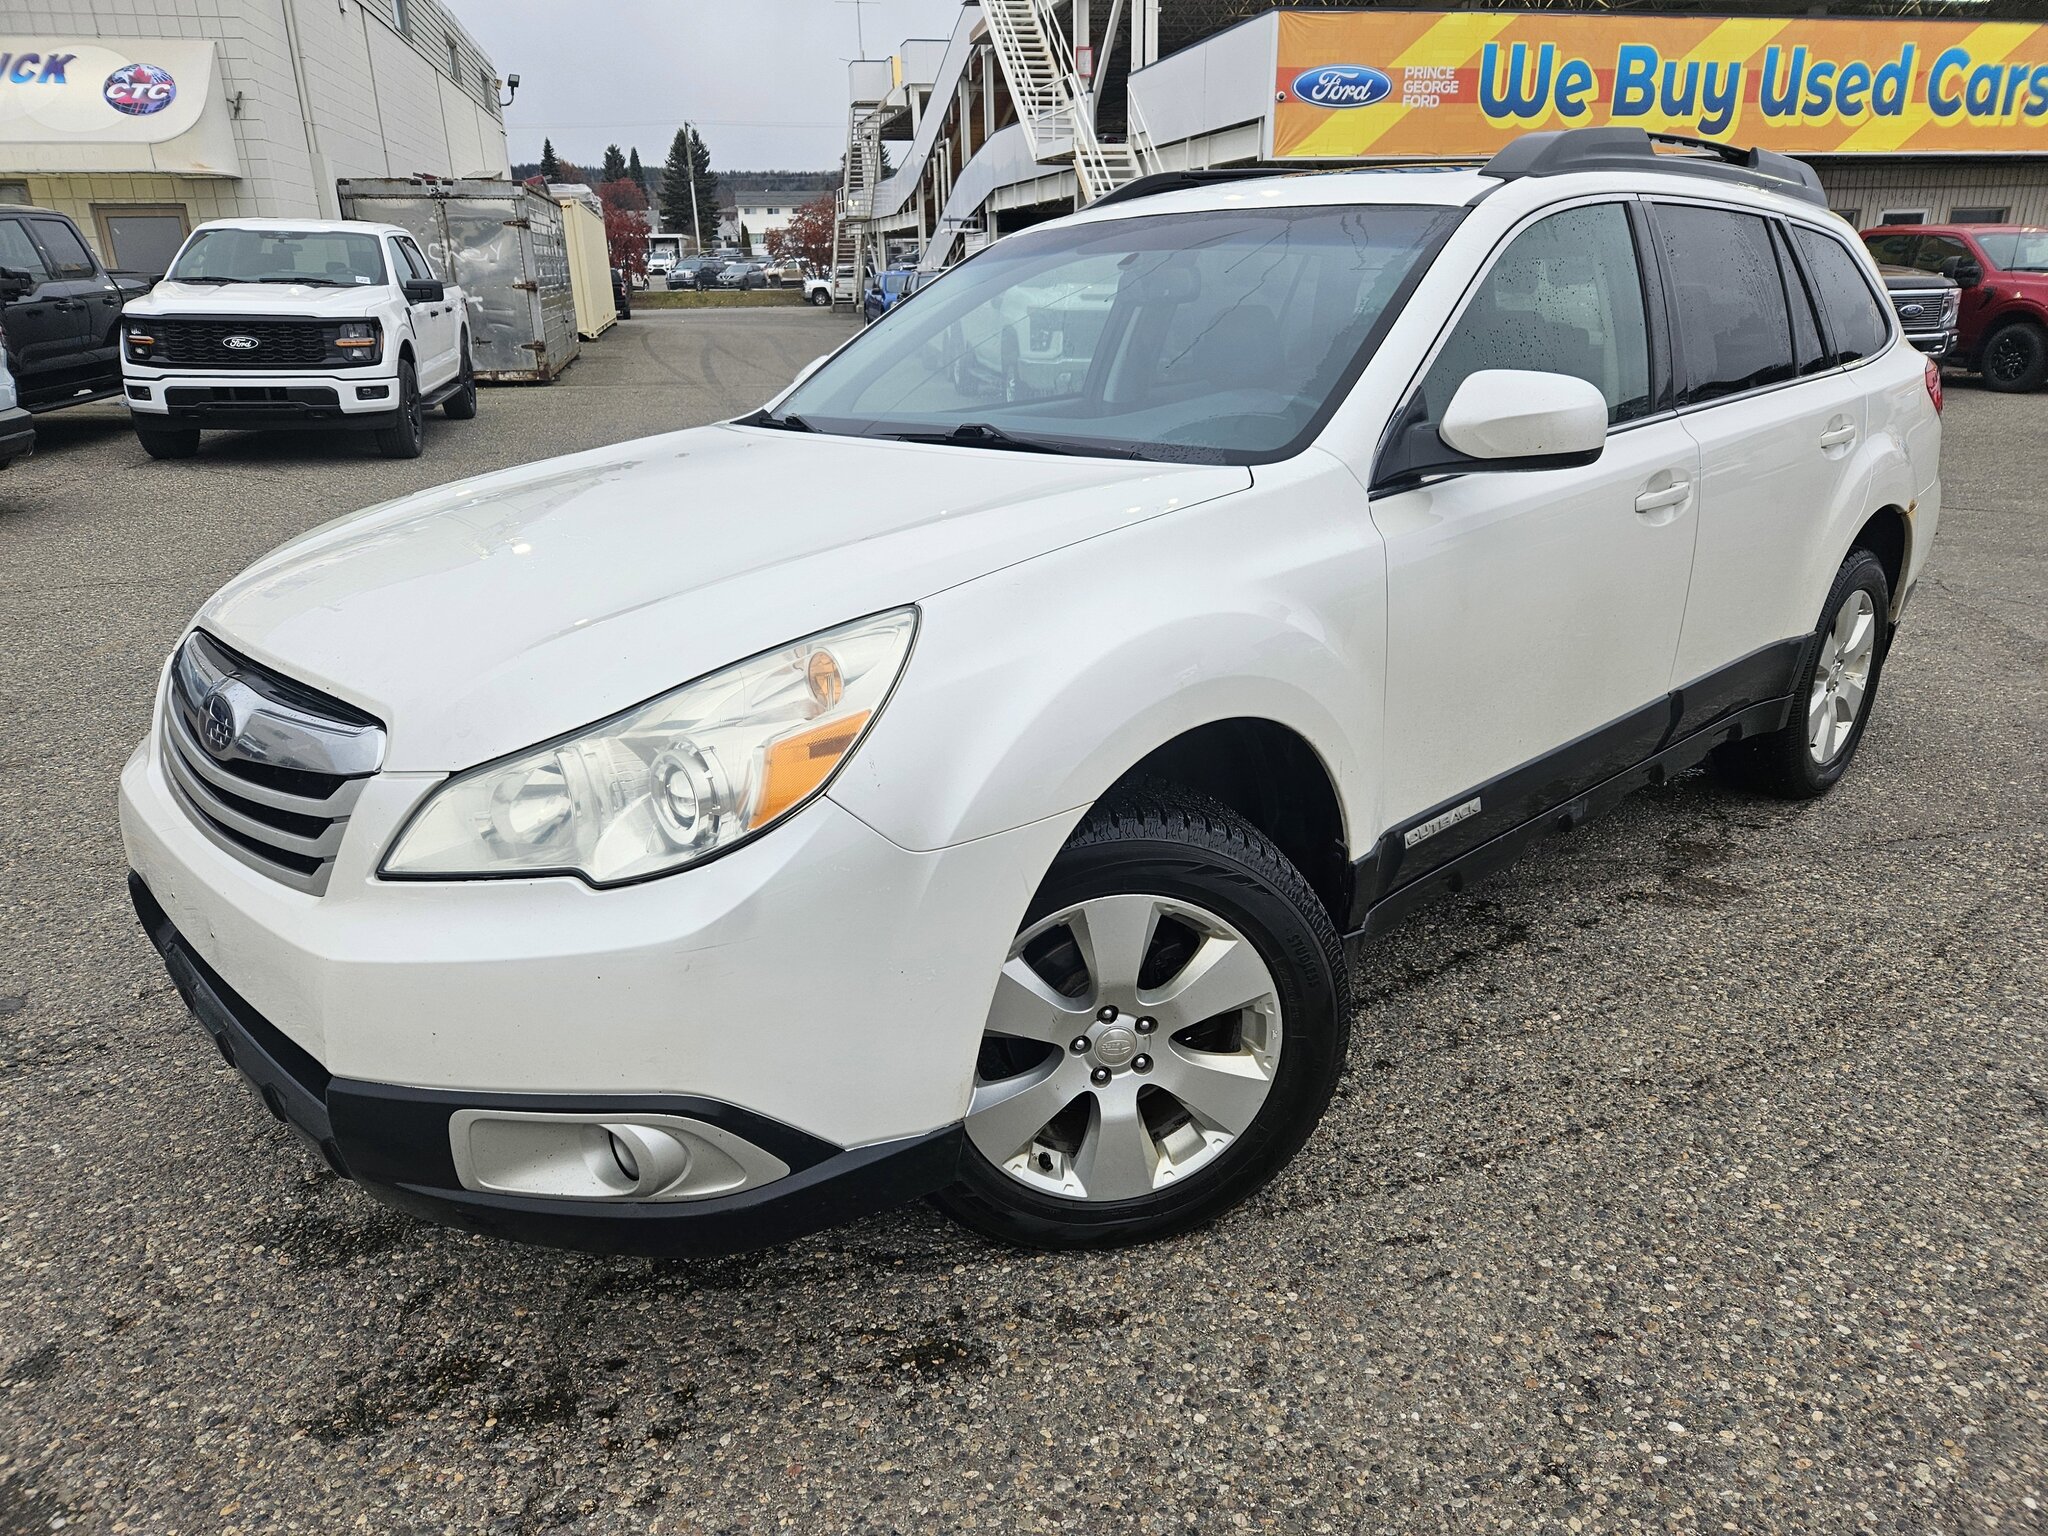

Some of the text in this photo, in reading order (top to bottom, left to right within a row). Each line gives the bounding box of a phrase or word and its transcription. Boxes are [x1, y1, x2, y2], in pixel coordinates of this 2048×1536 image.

[1404, 66, 1456, 80] PRINCE
[106, 82, 171, 100] CTC
[1403, 80, 1460, 94] GEORGE
[1479, 43, 2048, 135] We Buy Used Cars
[1402, 95, 1441, 108] FORD
[1406, 800, 1480, 846] OUTBACK
